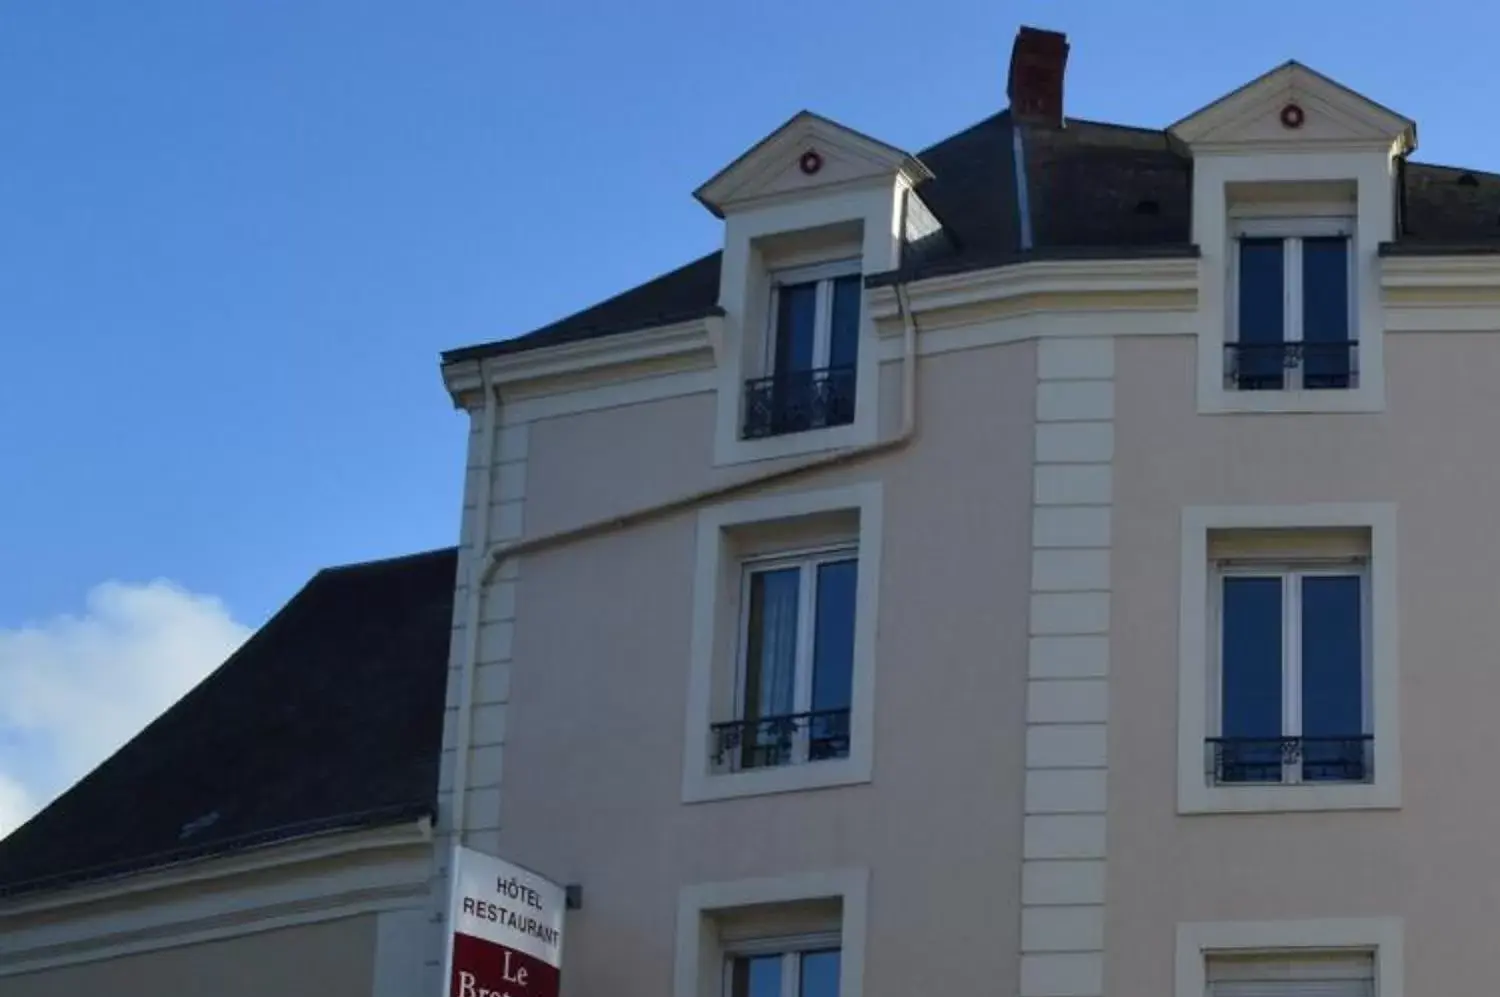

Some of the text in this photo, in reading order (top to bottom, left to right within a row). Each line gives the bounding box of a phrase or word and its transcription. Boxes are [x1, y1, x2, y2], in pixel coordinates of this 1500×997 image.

[496, 876, 543, 911] HÔTEL
[463, 896, 560, 949] RESTAURANT
[502, 951, 528, 986] Le
